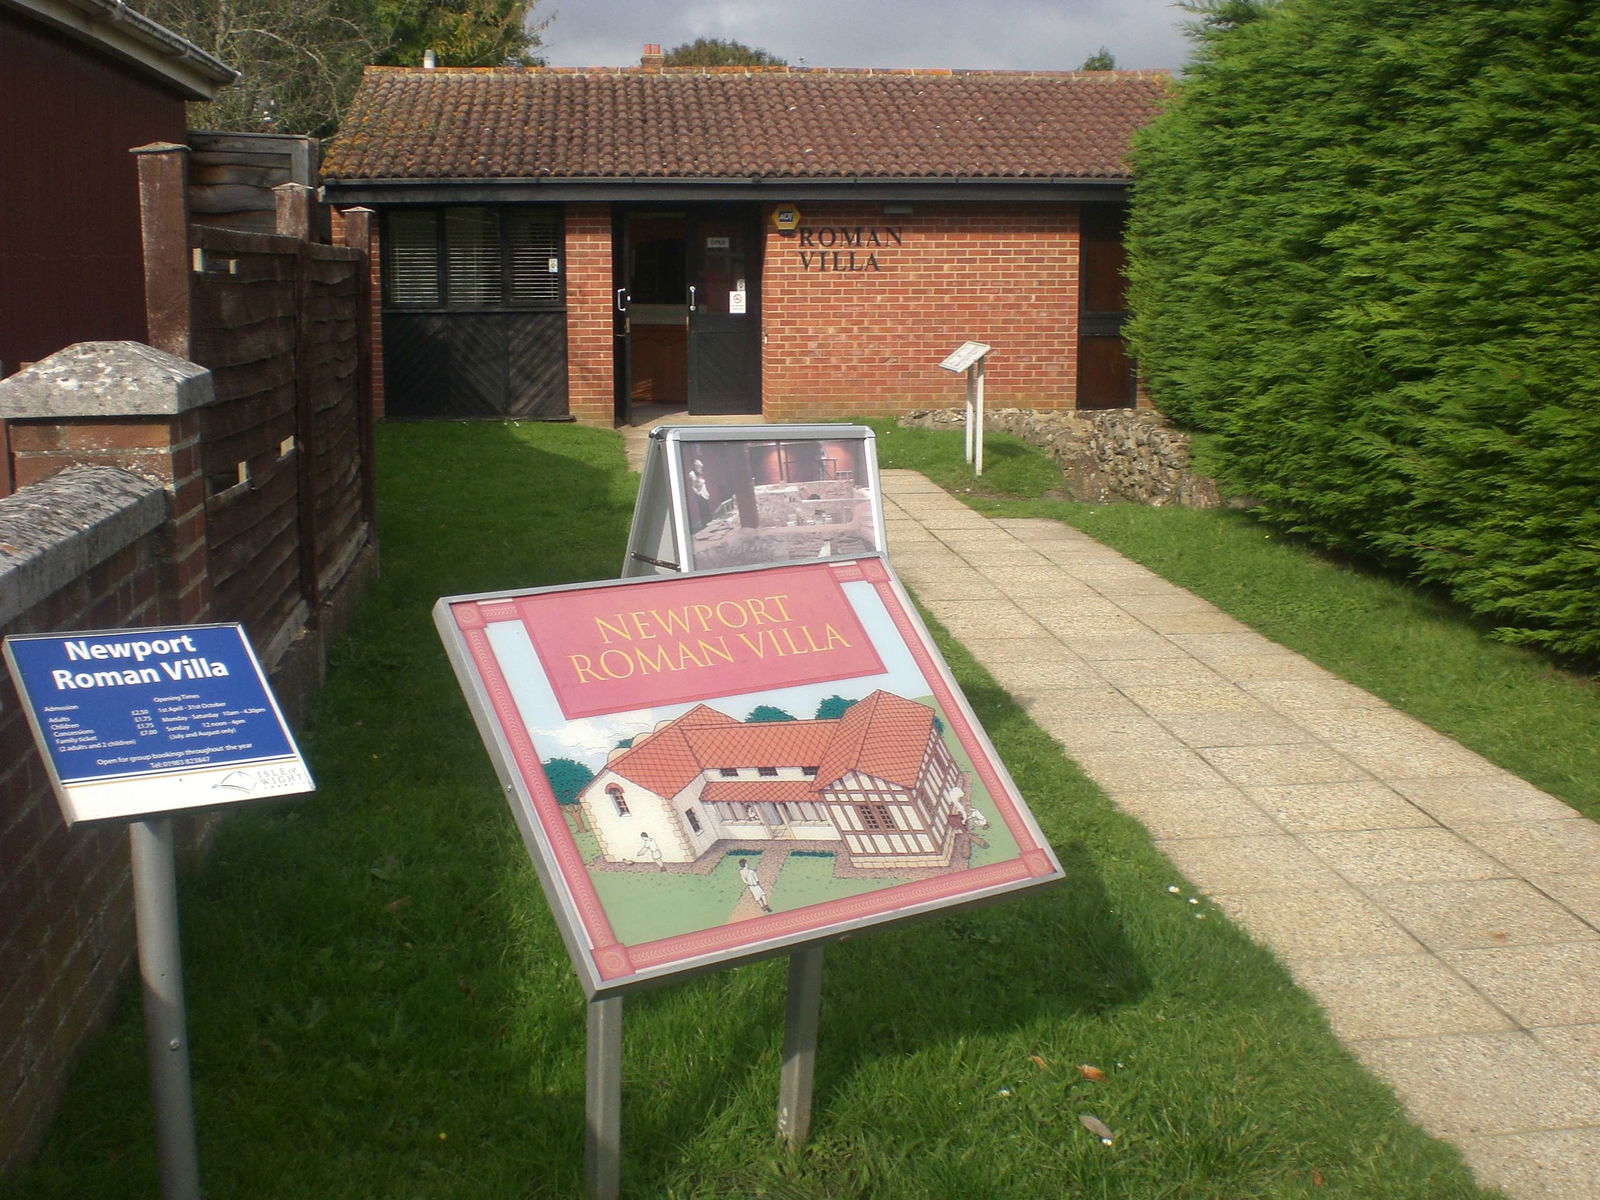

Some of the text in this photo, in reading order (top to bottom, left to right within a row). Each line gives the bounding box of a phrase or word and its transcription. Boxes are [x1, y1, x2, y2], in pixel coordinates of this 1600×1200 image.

[799, 226, 903, 248] ROMAN
[798, 250, 881, 272] VILLA
[594, 595, 792, 644] NEWPORT
[64, 634, 197, 661] Newport
[568, 623, 852, 684] ROMAN VILLA
[52, 657, 229, 690] Roman Villa
[44, 704, 79, 712] Admission
[161, 715, 188, 723] Monday
[191, 712, 219, 720] Saturday
[53, 729, 95, 737] Concessions
[55, 736, 78, 744] Family
[198, 729, 220, 737] August
[96, 758, 118, 766] Open
[117, 755, 129, 763] for
[129, 753, 152, 763] group
[151, 751, 185, 759] bookings
[184, 746, 225, 756] throughout
[238, 743, 253, 751] year
[257, 767, 287, 779] ISLE
[259, 773, 303, 785] WIGHT
